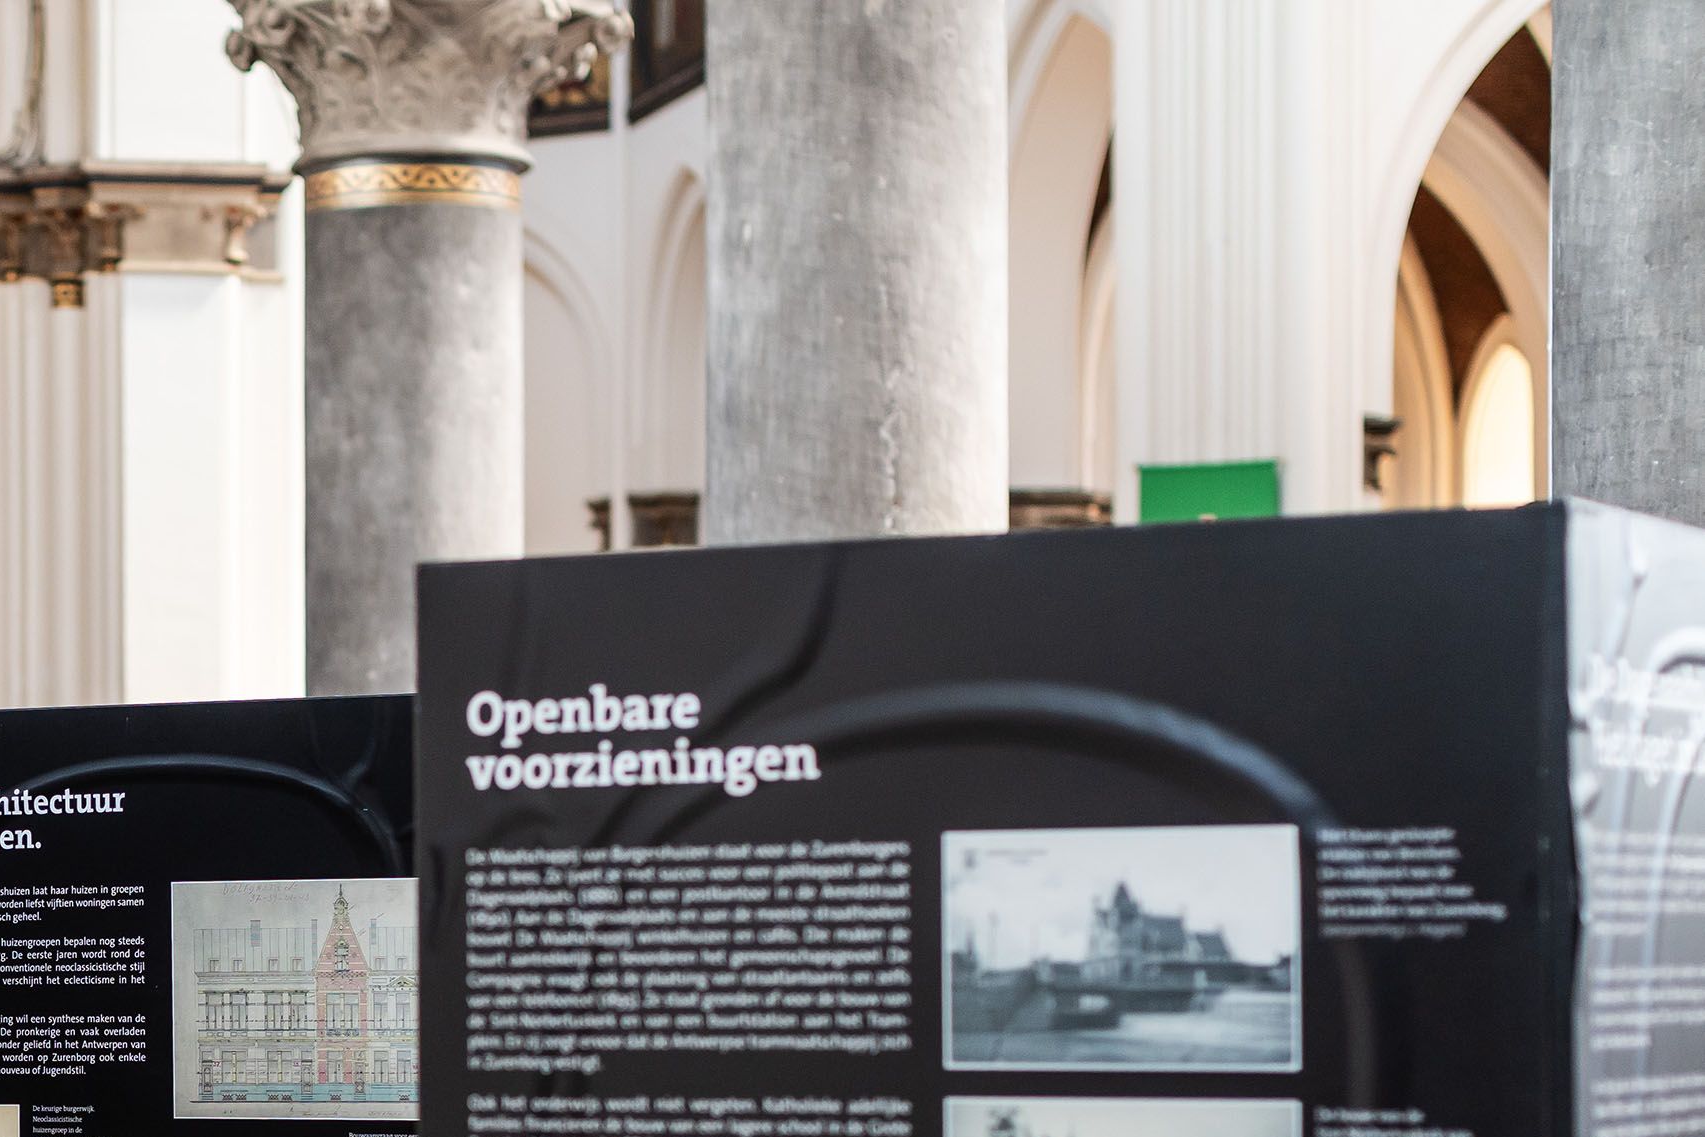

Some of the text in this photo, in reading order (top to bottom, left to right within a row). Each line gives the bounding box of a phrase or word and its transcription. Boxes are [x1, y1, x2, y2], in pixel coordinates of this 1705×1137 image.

[466, 684, 700, 747] Openbare
[466, 739, 820, 796] voorzieningen
[32, 885, 47, 895] laat
[50, 885, 68, 895] haar
[71, 884, 97, 894] huizen
[100, 884, 108, 893] in
[110, 885, 144, 896] groepen
[25, 898, 44, 908] liefst
[46, 897, 74, 910] vijftien
[75, 897, 115, 910] woningen
[117, 898, 144, 906] samen
[12, 911, 41, 924] geheel.
[0, 936, 60, 950] huizengroepen
[63, 936, 96, 948] bepalen
[99, 938, 115, 948] nog
[118, 935, 144, 945] steeds
[11, 950, 23, 959] De
[26, 950, 52, 959] eerste
[56, 949, 77, 961] jaren
[81, 949, 106, 958] wordt
[110, 948, 130, 958] rond
[134, 948, 145, 958] de
[55, 961, 126, 972] neoclassicistische
[129, 961, 145, 973] stijl
[2, 975, 42, 987] verschijnt
[46, 975, 60, 984] het
[63, 974, 115, 984] eclecticisme
[118, 974, 126, 984] in
[130, 974, 145, 984] het
[15, 1014, 28, 1023] wil
[48, 1014, 84, 1026] synthese
[87, 1013, 114, 1023] maken
[134, 1013, 145, 1022] de
[0, 1027, 11, 1036] De
[16, 1026, 60, 1038] pronkerige
[64, 1028, 75, 1036] en
[79, 1026, 99, 1036] vaak
[103, 1026, 145, 1036] overladen
[23, 1039, 51, 1051] geliefd
[54, 1039, 62, 1048] in
[65, 1039, 78, 1049] het
[81, 1040, 127, 1051] Antwerpen
[2, 1052, 33, 1061] worden
[37, 1054, 48, 1064] op
[52, 1052, 95, 1064] Zurenborg
[98, 1052, 114, 1061] ook
[118, 1052, 146, 1062] enkele
[31, 1064, 40, 1074] of
[42, 1065, 86, 1077] Jugendstil.
